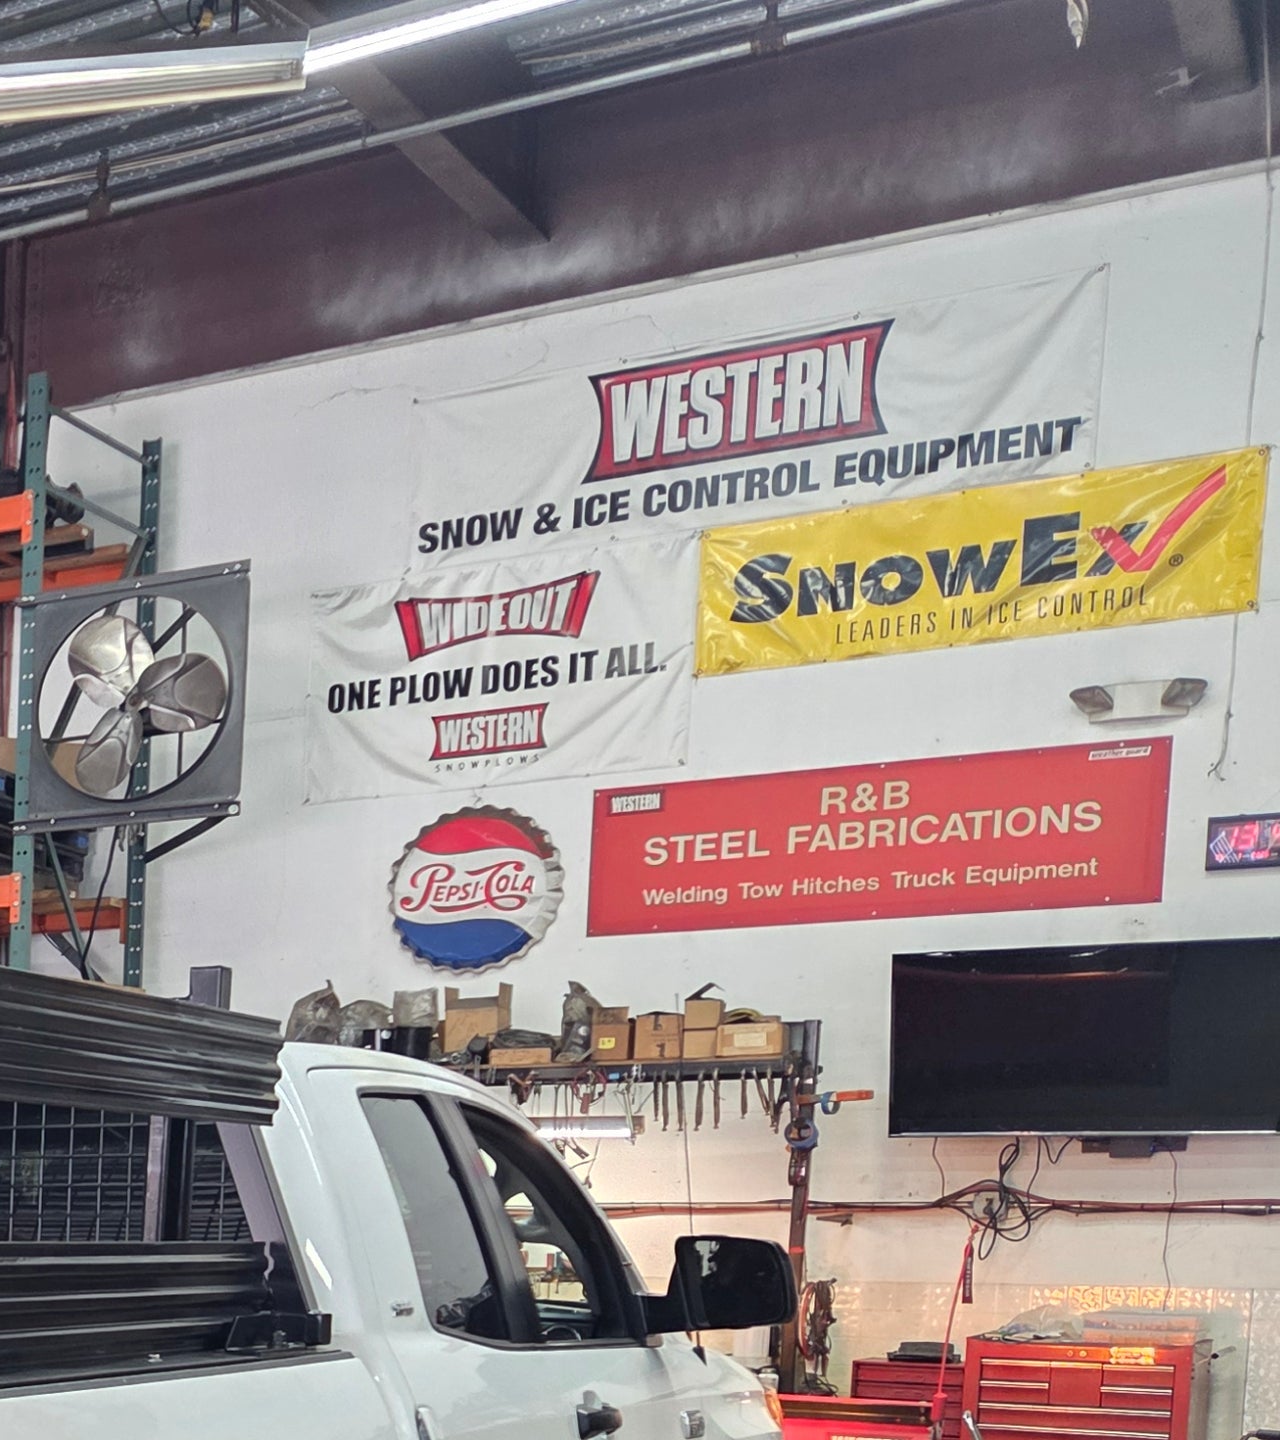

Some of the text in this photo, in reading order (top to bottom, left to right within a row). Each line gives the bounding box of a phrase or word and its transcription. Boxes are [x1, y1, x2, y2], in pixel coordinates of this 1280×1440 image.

[610, 337, 867, 465] WESTERN
[417, 416, 1084, 553] SNOW & ICE CONTROL EQUIPMENT
[416, 579, 579, 651] WIDEOUT
[835, 584, 1149, 645] LEADERS IN ICE CONTROL
[327, 641, 663, 714] ONE PLOW DOES IT ALL.
[439, 708, 540, 755] WESTERN
[434, 753, 541, 774] SNOWPLOWS
[611, 792, 662, 814] WESTERN
[820, 780, 911, 816] R&B
[643, 800, 1104, 867] STEEL FABRICATIONS
[642, 856, 1099, 908] Welding Tow Hitches Truck Equipment
